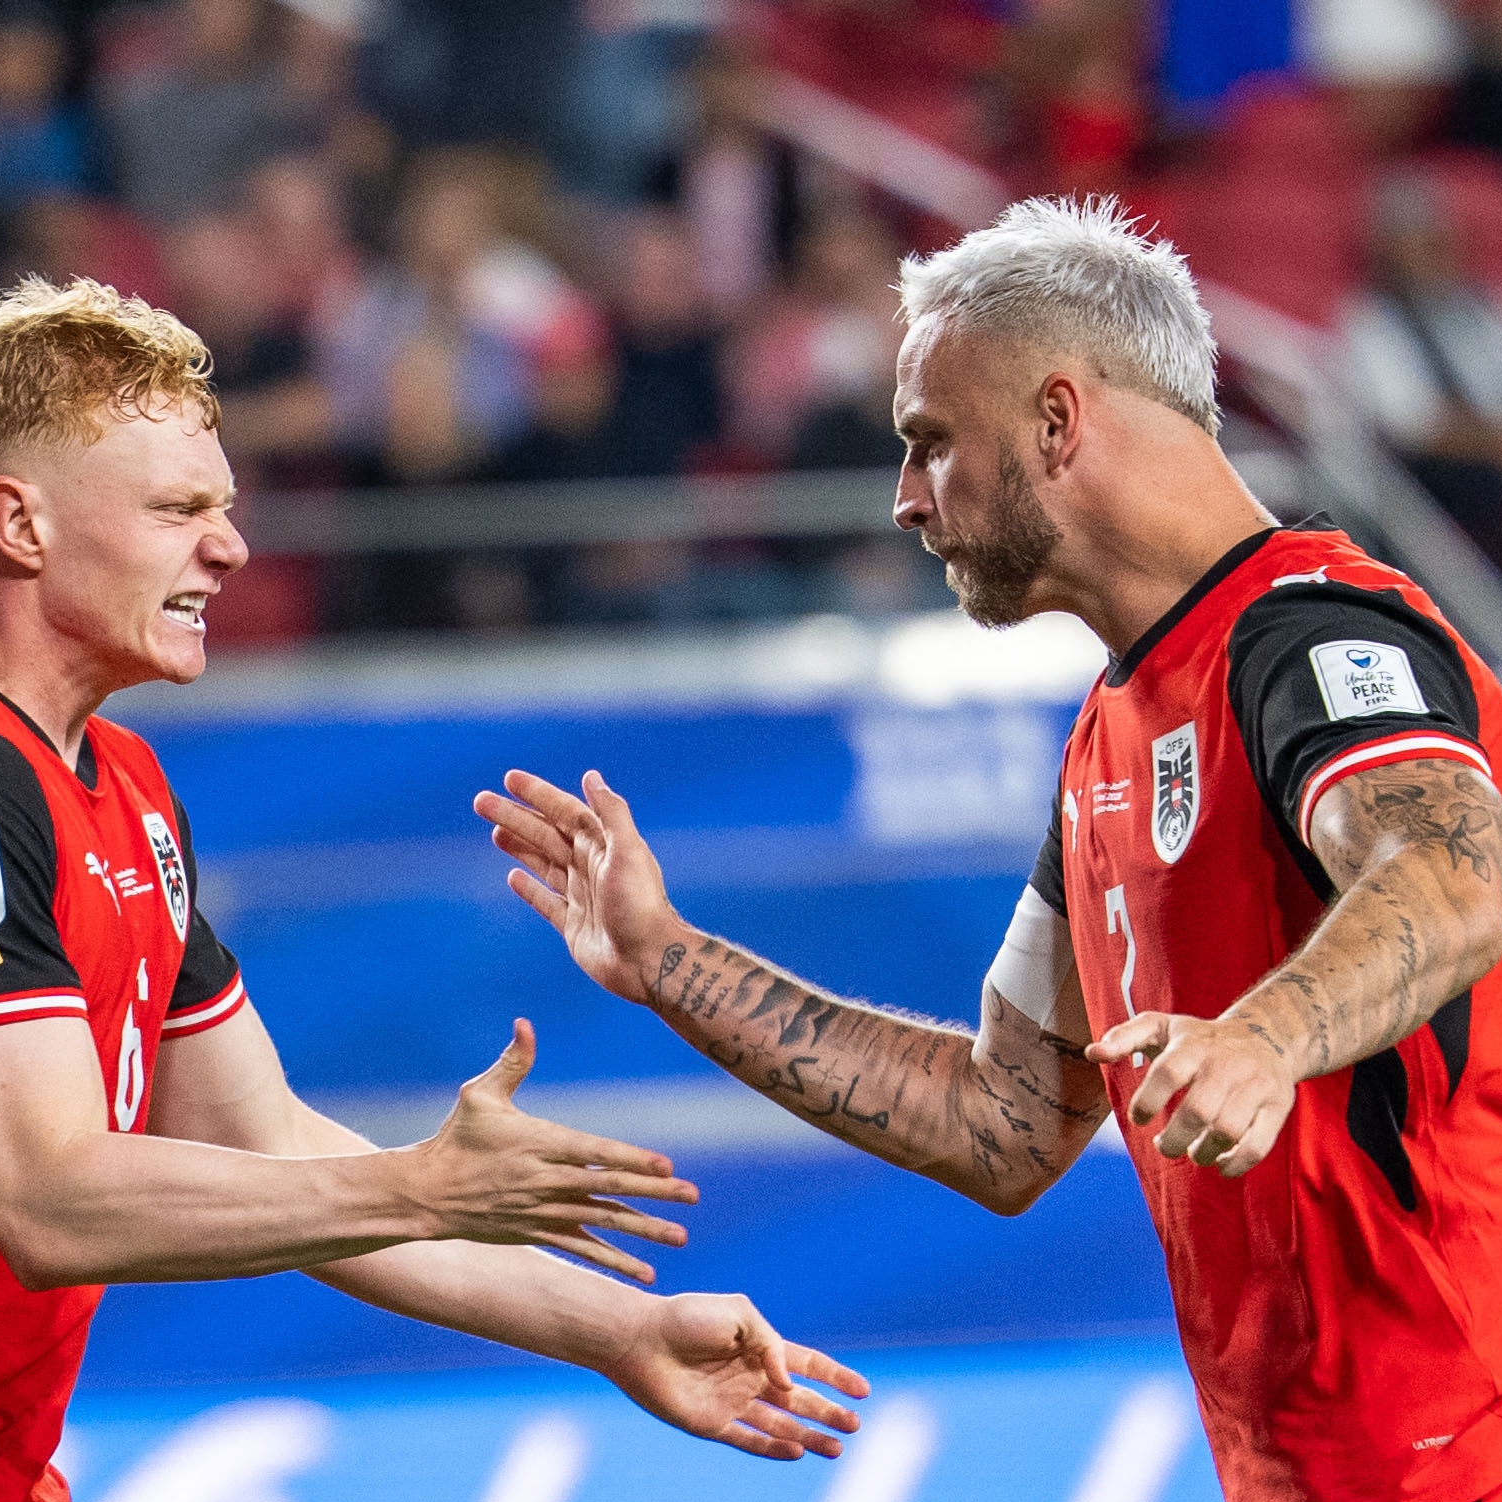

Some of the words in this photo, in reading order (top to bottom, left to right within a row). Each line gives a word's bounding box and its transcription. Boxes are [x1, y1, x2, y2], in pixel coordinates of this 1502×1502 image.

[1351, 682, 1398, 700] PEACE
[1365, 696, 1390, 707] FIFA
[1104, 883, 1145, 1068] 7
